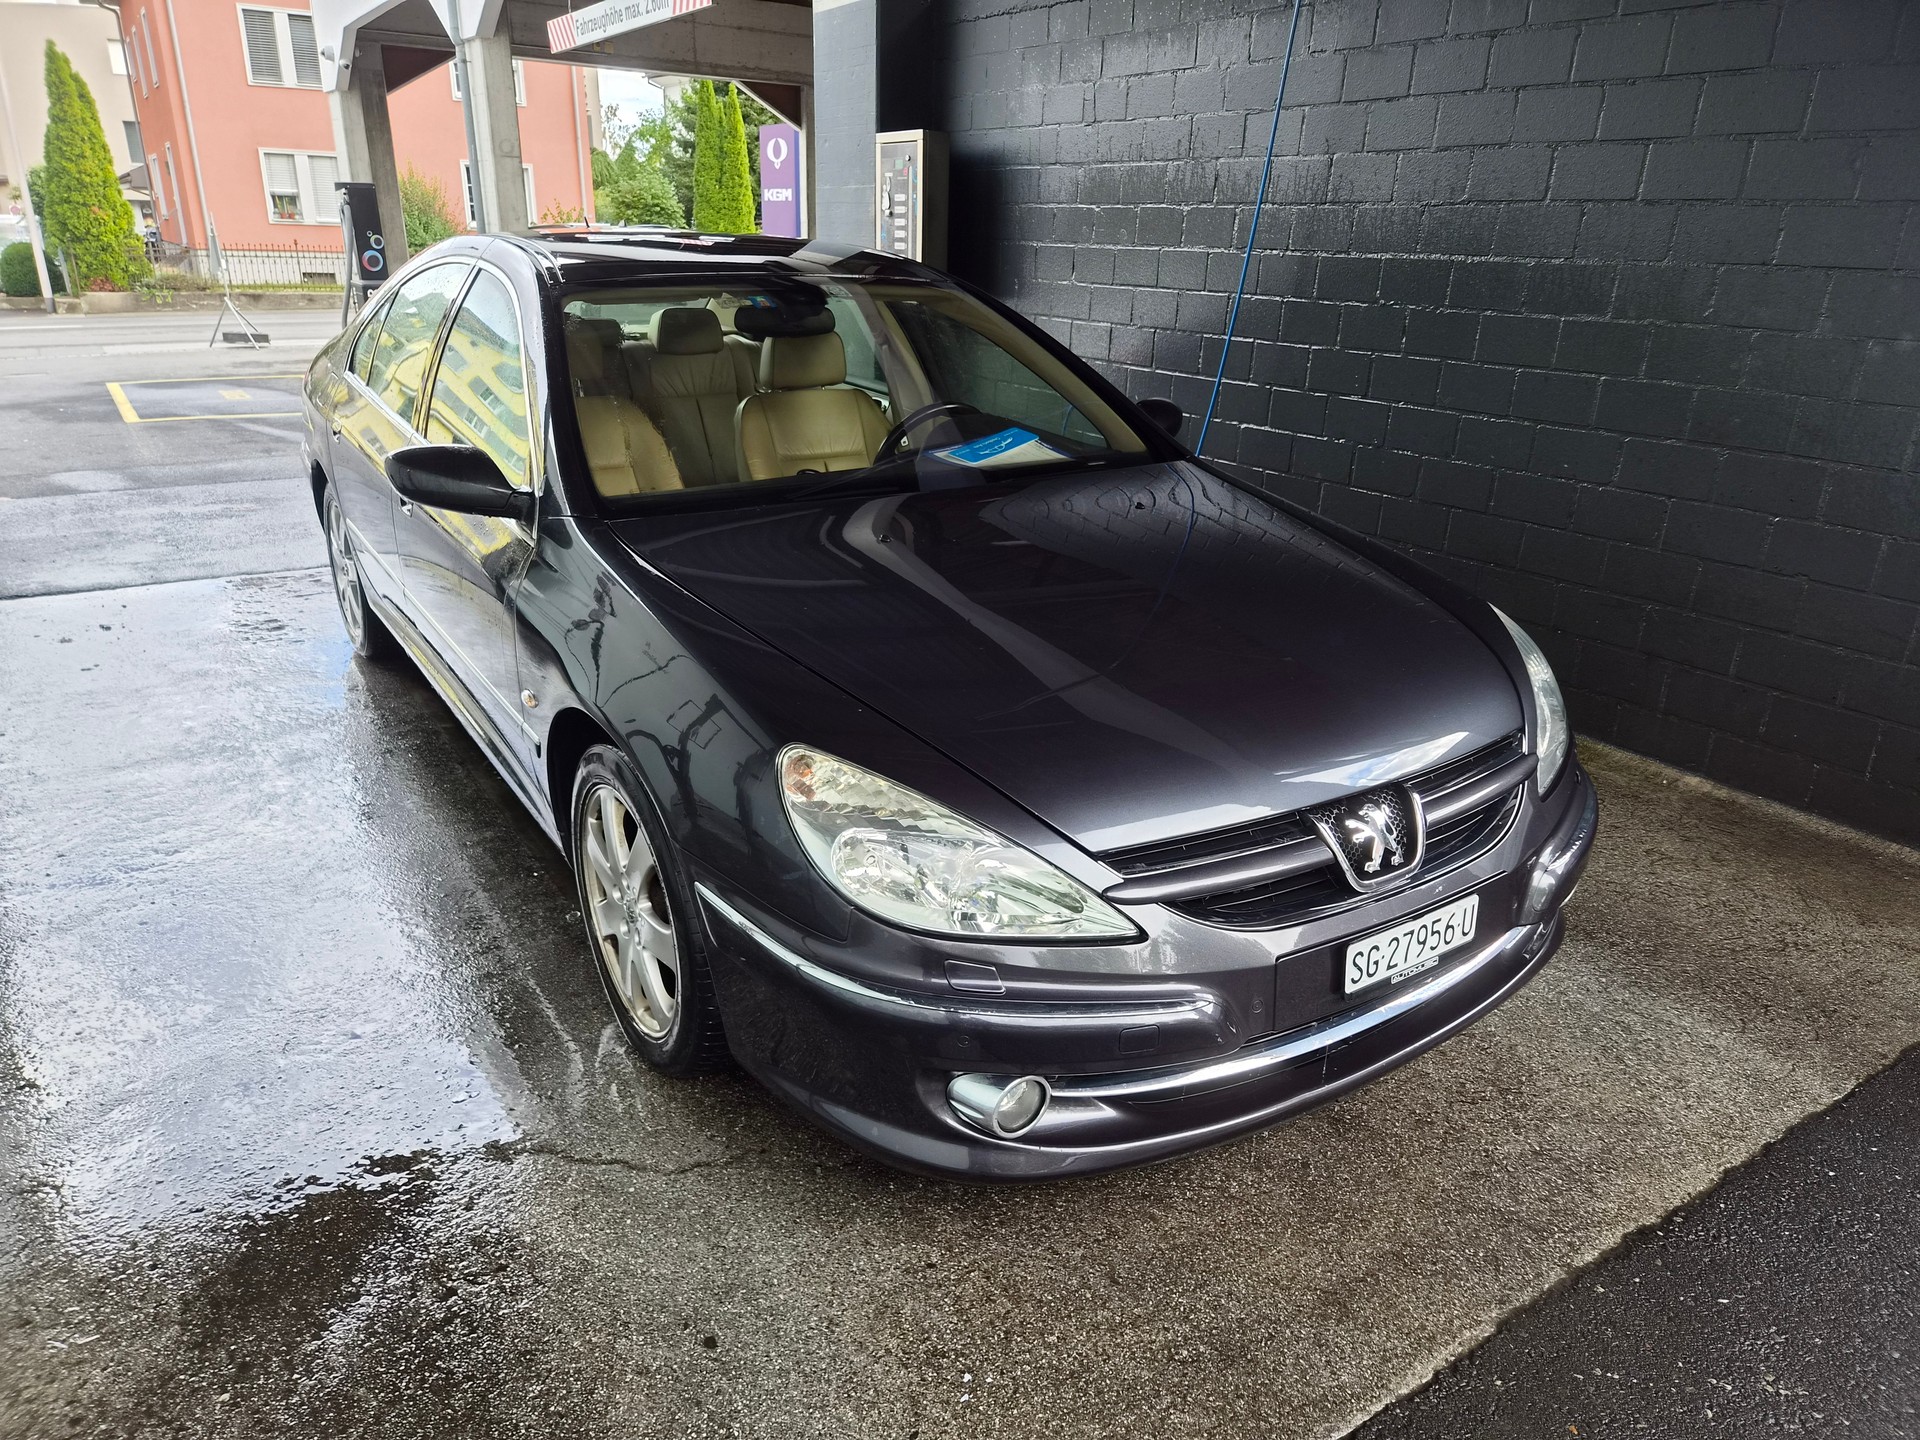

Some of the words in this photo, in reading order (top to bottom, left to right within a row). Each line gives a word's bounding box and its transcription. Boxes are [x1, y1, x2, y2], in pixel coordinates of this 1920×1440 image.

[575, 6, 624, 37] Fahrzeughöhe
[625, 2, 644, 21] max.
[764, 188, 793, 202] KGM
